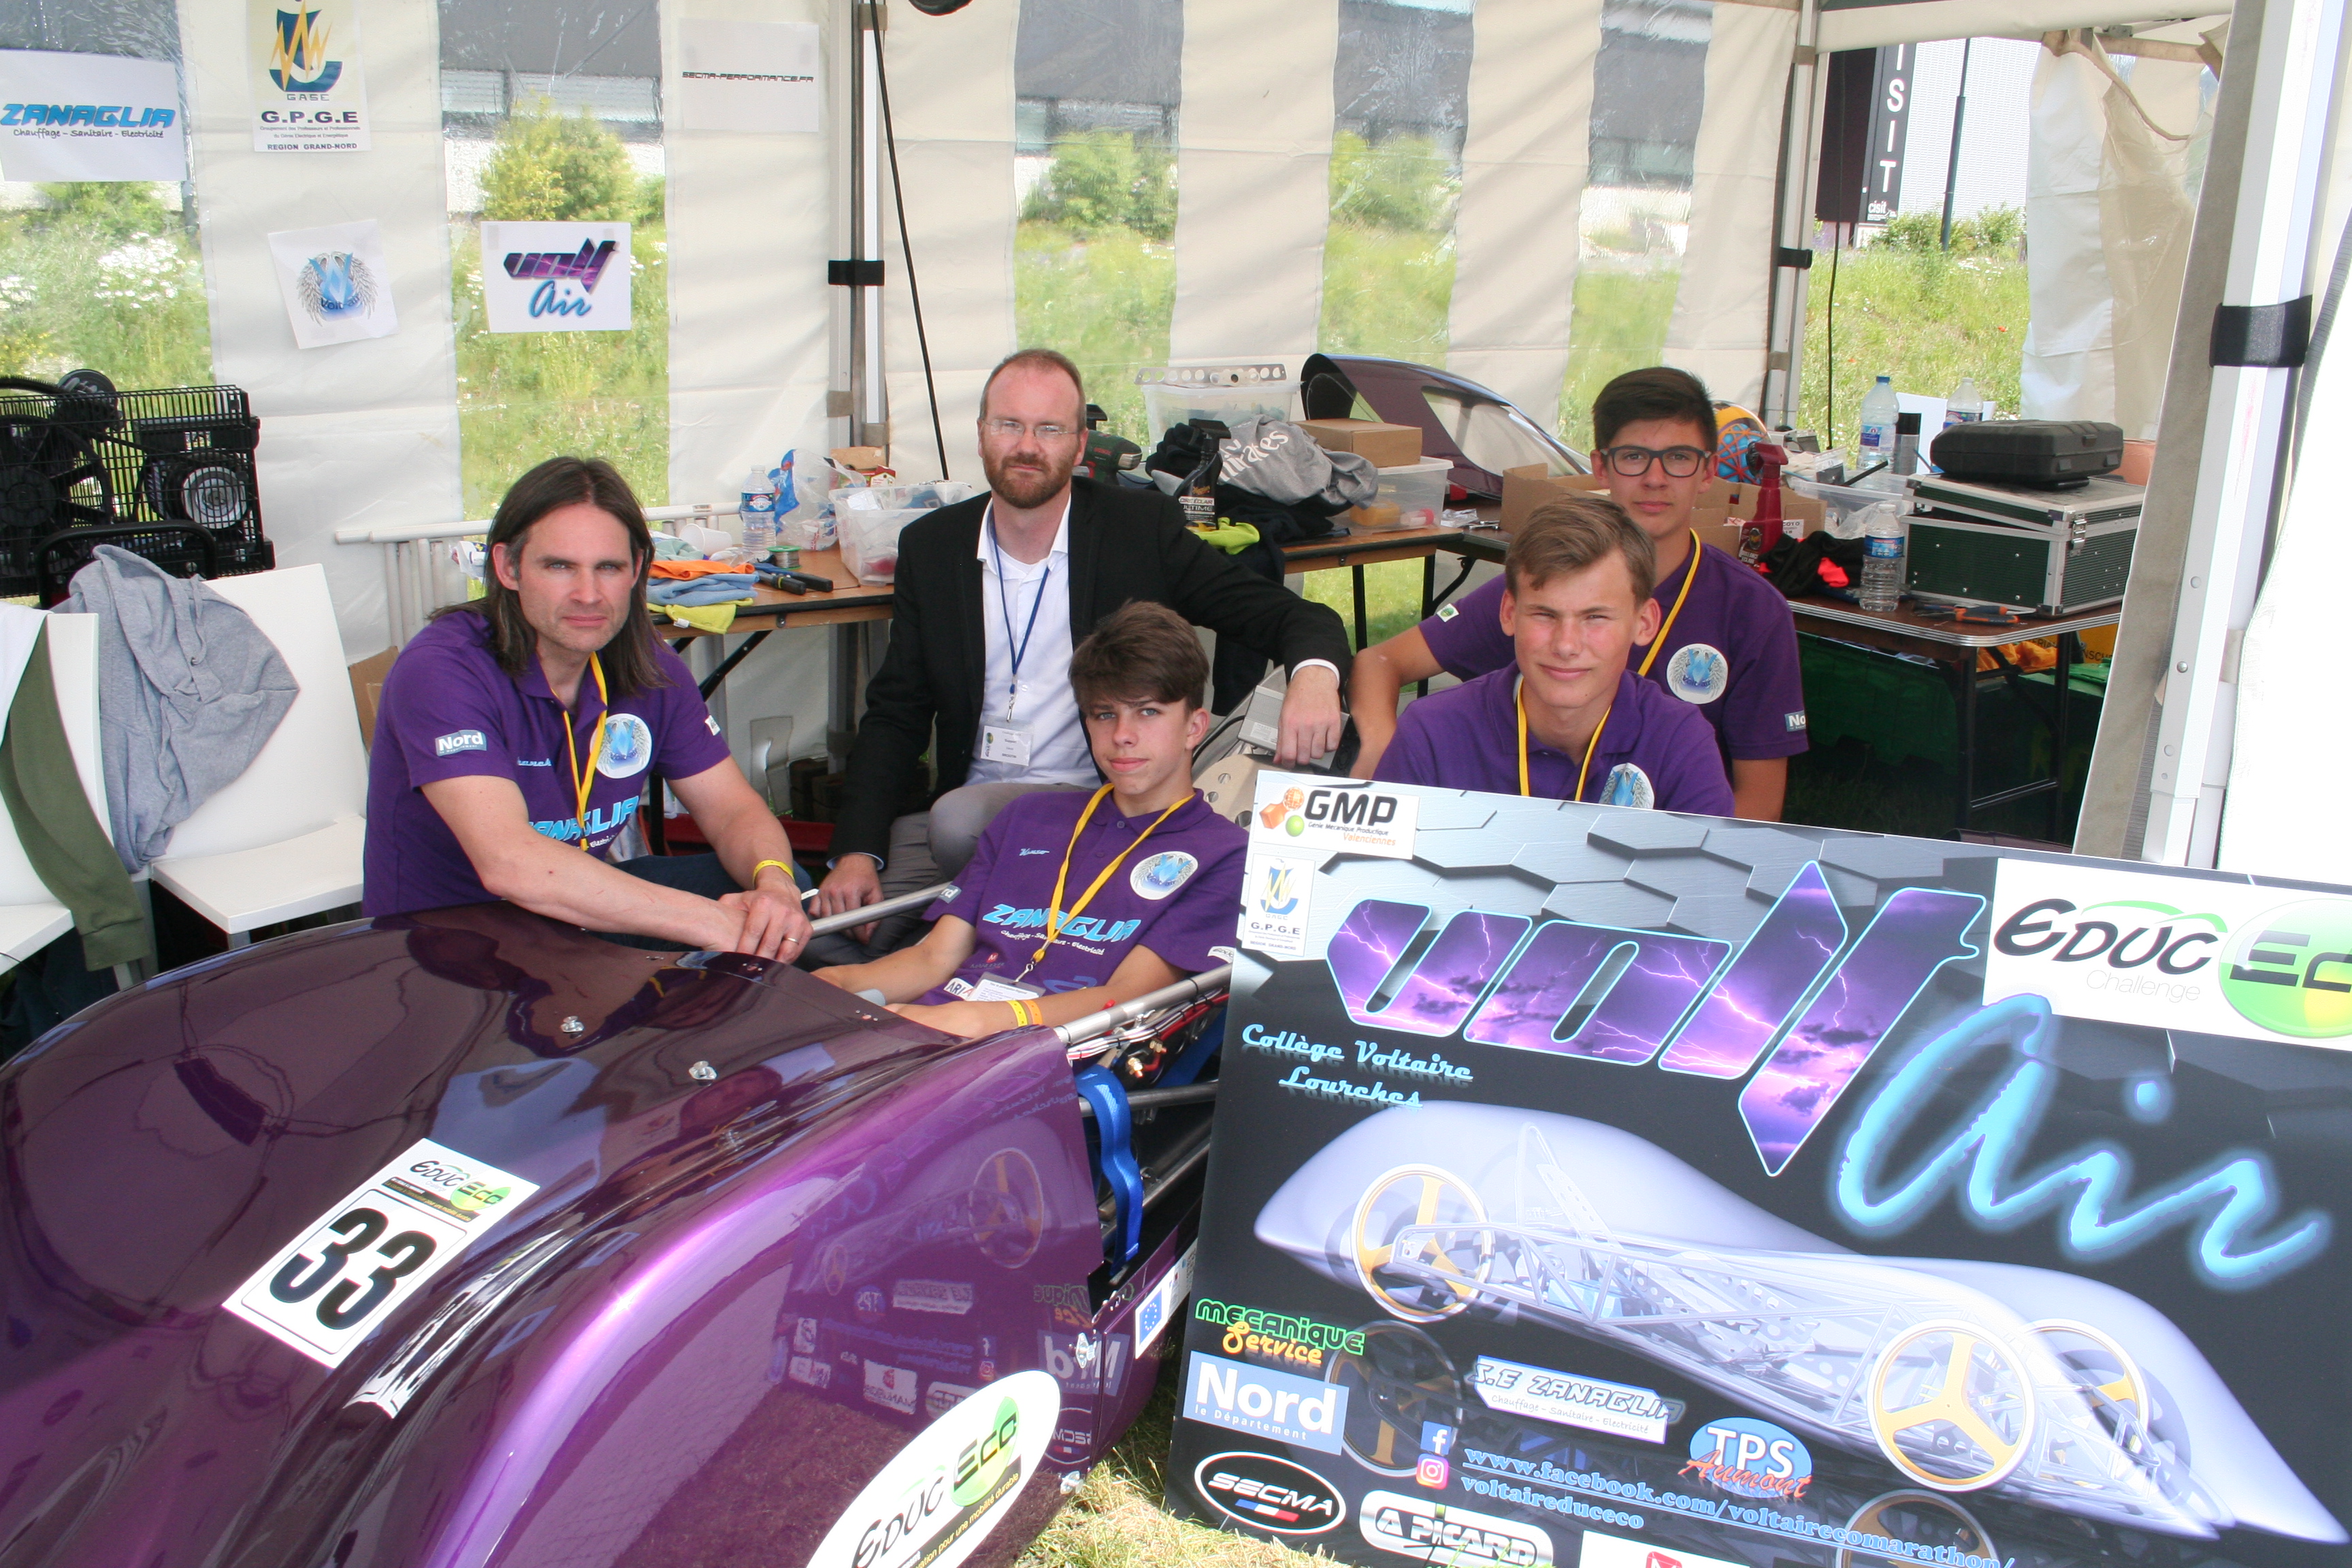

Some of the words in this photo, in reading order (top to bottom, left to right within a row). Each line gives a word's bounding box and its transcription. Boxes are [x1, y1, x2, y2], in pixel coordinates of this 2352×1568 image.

[1, 103, 176, 128] ZANAGLIA
[14, 128, 61, 139] Chauffage
[70, 129, 112, 137] Sanitaire
[261, 111, 358, 123] G.P.G.E
[528, 280, 592, 318] Air
[438, 732, 484, 751] Nord
[1788, 715, 1806, 727] No
[1304, 789, 1398, 826] GMP
[1343, 832, 1396, 846] Valenciennes
[1993, 898, 2219, 975] EDUC
[2087, 970, 2200, 1003] Challenge
[1242, 1024, 1345, 1062] Collège
[1354, 1040, 1473, 1081] Voltaire
[1278, 1066, 1424, 1109] Lourches
[1838, 993, 2322, 1279] Air
[410, 1160, 465, 1187] EDUC
[270, 1207, 437, 1330] 33
[1222, 1320, 1323, 1365] Service
[1196, 1362, 1337, 1434] Nord
[1467, 1363, 1522, 1389] S.E
[1527, 1375, 1684, 1422] ZANAGLIA
[1491, 1394, 1539, 1412] Chauffage
[1548, 1407, 1594, 1423] Sanitaire
[1194, 1404, 1207, 1416] le
[1214, 1409, 1307, 1441] Département
[1706, 1426, 1795, 1478] TPS
[1208, 1471, 1333, 1517] SECMA
[1678, 1450, 1814, 1499] Aumont
[938, 1532, 955, 1554] pour
[956, 1520, 968, 1537] une
[969, 1496, 995, 1522] mobilité
[995, 1473, 1019, 1499] durable
[1460, 1475, 1645, 1530] voltaireduceco
[1411, 1512, 1537, 1567] PICARD
